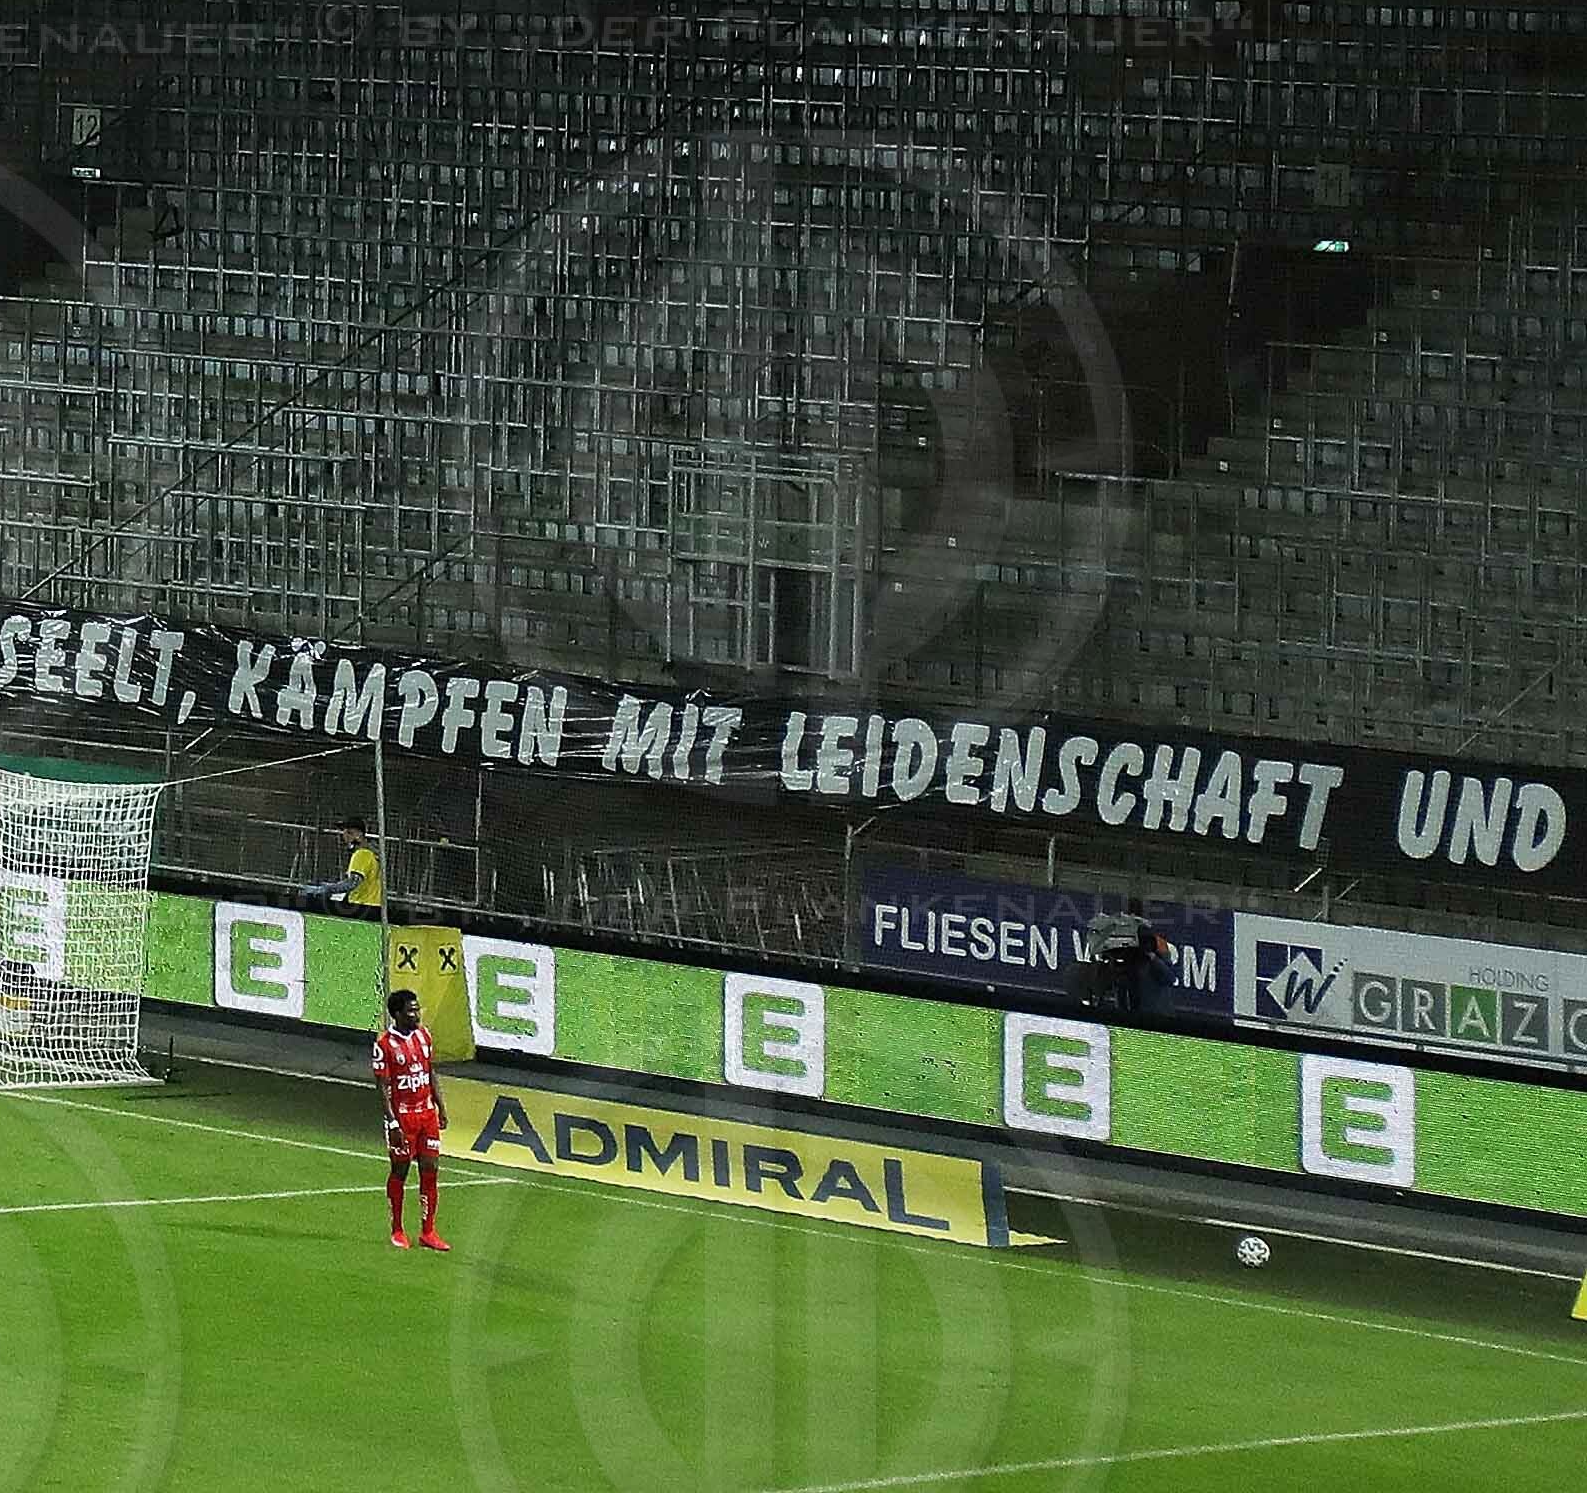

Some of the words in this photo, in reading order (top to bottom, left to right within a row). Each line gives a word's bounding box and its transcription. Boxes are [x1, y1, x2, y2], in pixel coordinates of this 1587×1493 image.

[74, 114, 101, 141] 12
[228, 637, 566, 767] KÄMPFEN
[602, 693, 742, 785] MIT
[779, 710, 1344, 851] LEIDENSCHAFT
[1396, 769, 1568, 874] UND
[230, 920, 288, 999] E
[873, 903, 1058, 971] FLIESEN
[477, 953, 538, 1033] E
[1358, 979, 1540, 1045] GRAZ
[1469, 965, 1550, 992] HOLDING
[742, 992, 805, 1075] E
[1023, 1032, 1094, 1121] E
[1321, 1075, 1395, 1166] E
[470, 1095, 950, 1231] ADMIRAL
